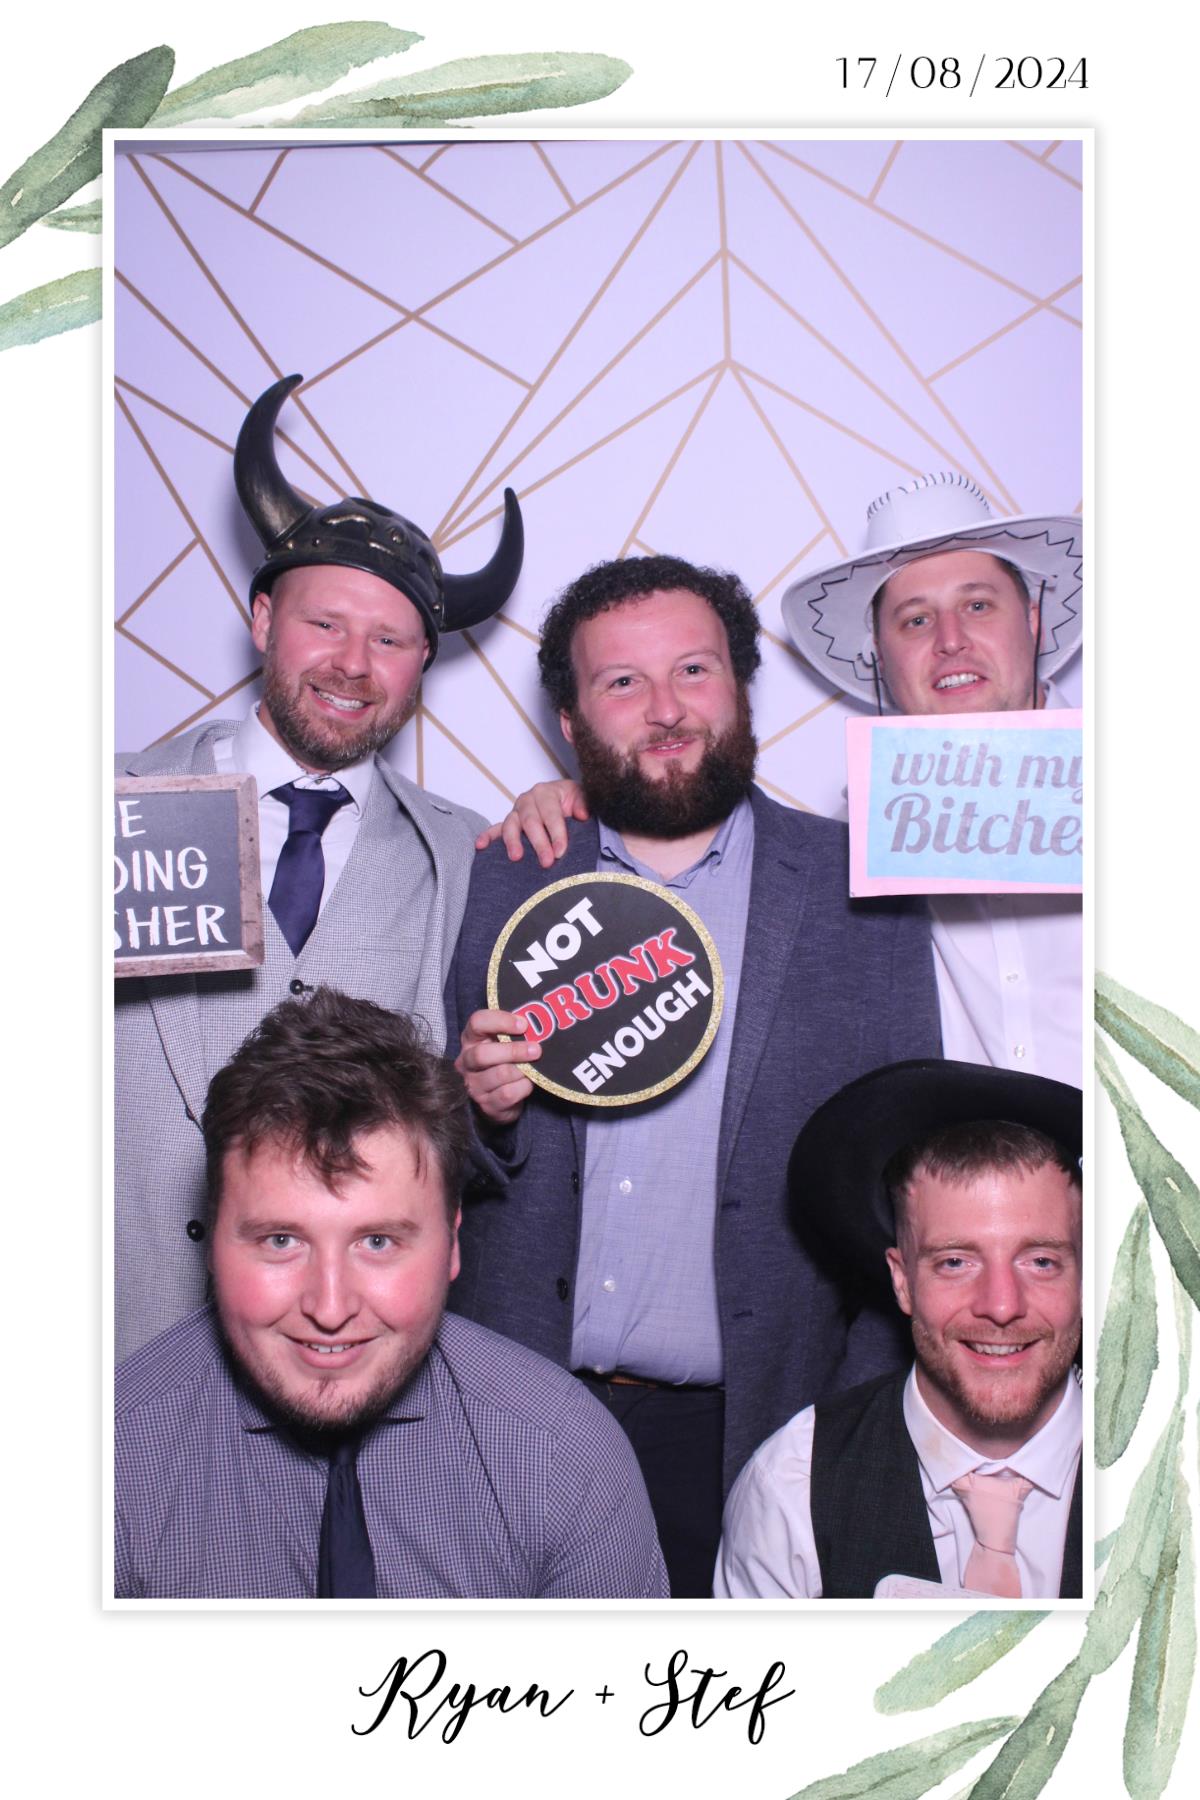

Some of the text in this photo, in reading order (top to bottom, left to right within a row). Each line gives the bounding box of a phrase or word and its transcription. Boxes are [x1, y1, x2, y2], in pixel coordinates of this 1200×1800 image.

[890, 740, 1003, 788] with
[114, 800, 147, 838] E
[883, 792, 1082, 857] Bitche
[512, 896, 604, 989] NOT
[511, 927, 696, 1044] DRUNK
[571, 968, 712, 1094] ENOUGH
